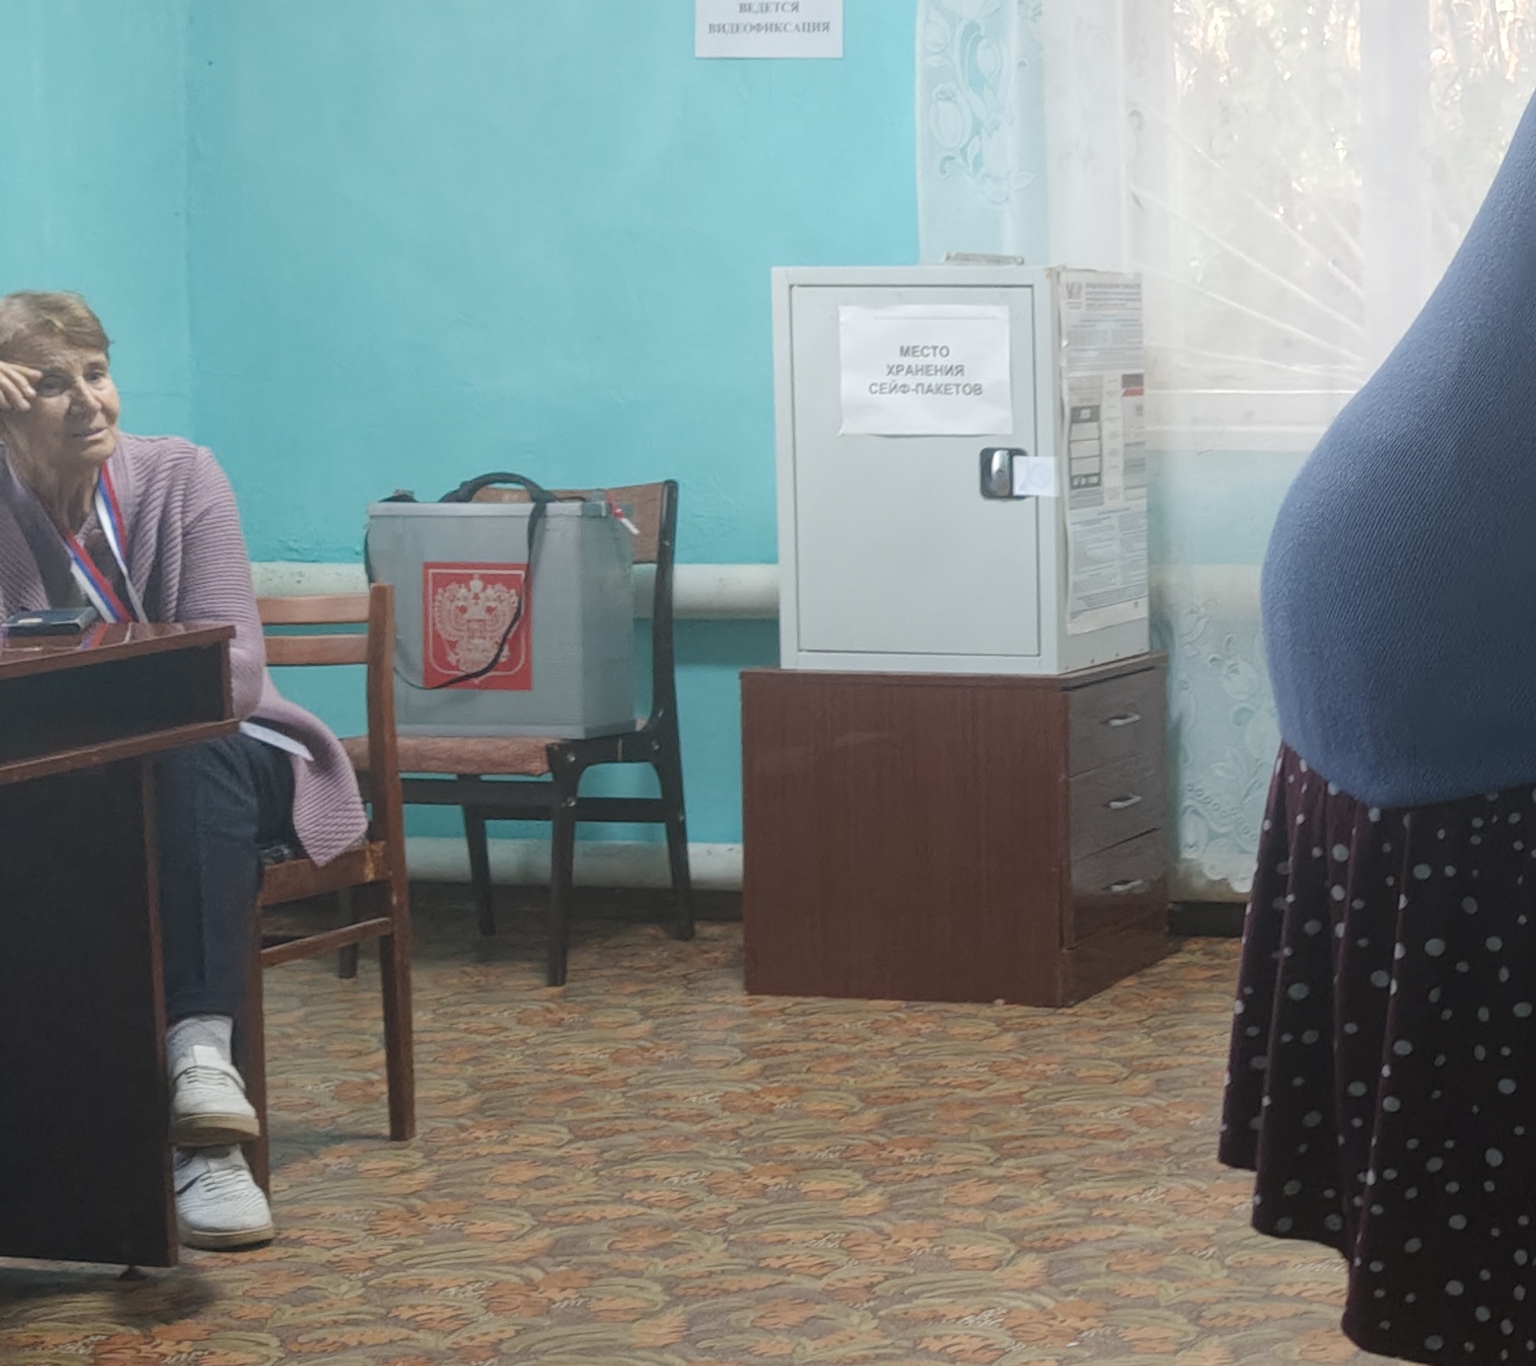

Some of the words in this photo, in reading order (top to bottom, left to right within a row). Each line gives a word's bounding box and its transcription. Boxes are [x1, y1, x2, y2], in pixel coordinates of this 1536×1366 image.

[738, 1, 800, 14] ВЕДЕТСЯ
[708, 22, 831, 35] ВИДЕОФИКСАЦИЯ
[899, 345, 950, 358] МЕСТО
[886, 364, 965, 376] ХРАНЕНИЯ
[868, 380, 983, 395] СЕЙФ-ПАКЕТОВ
